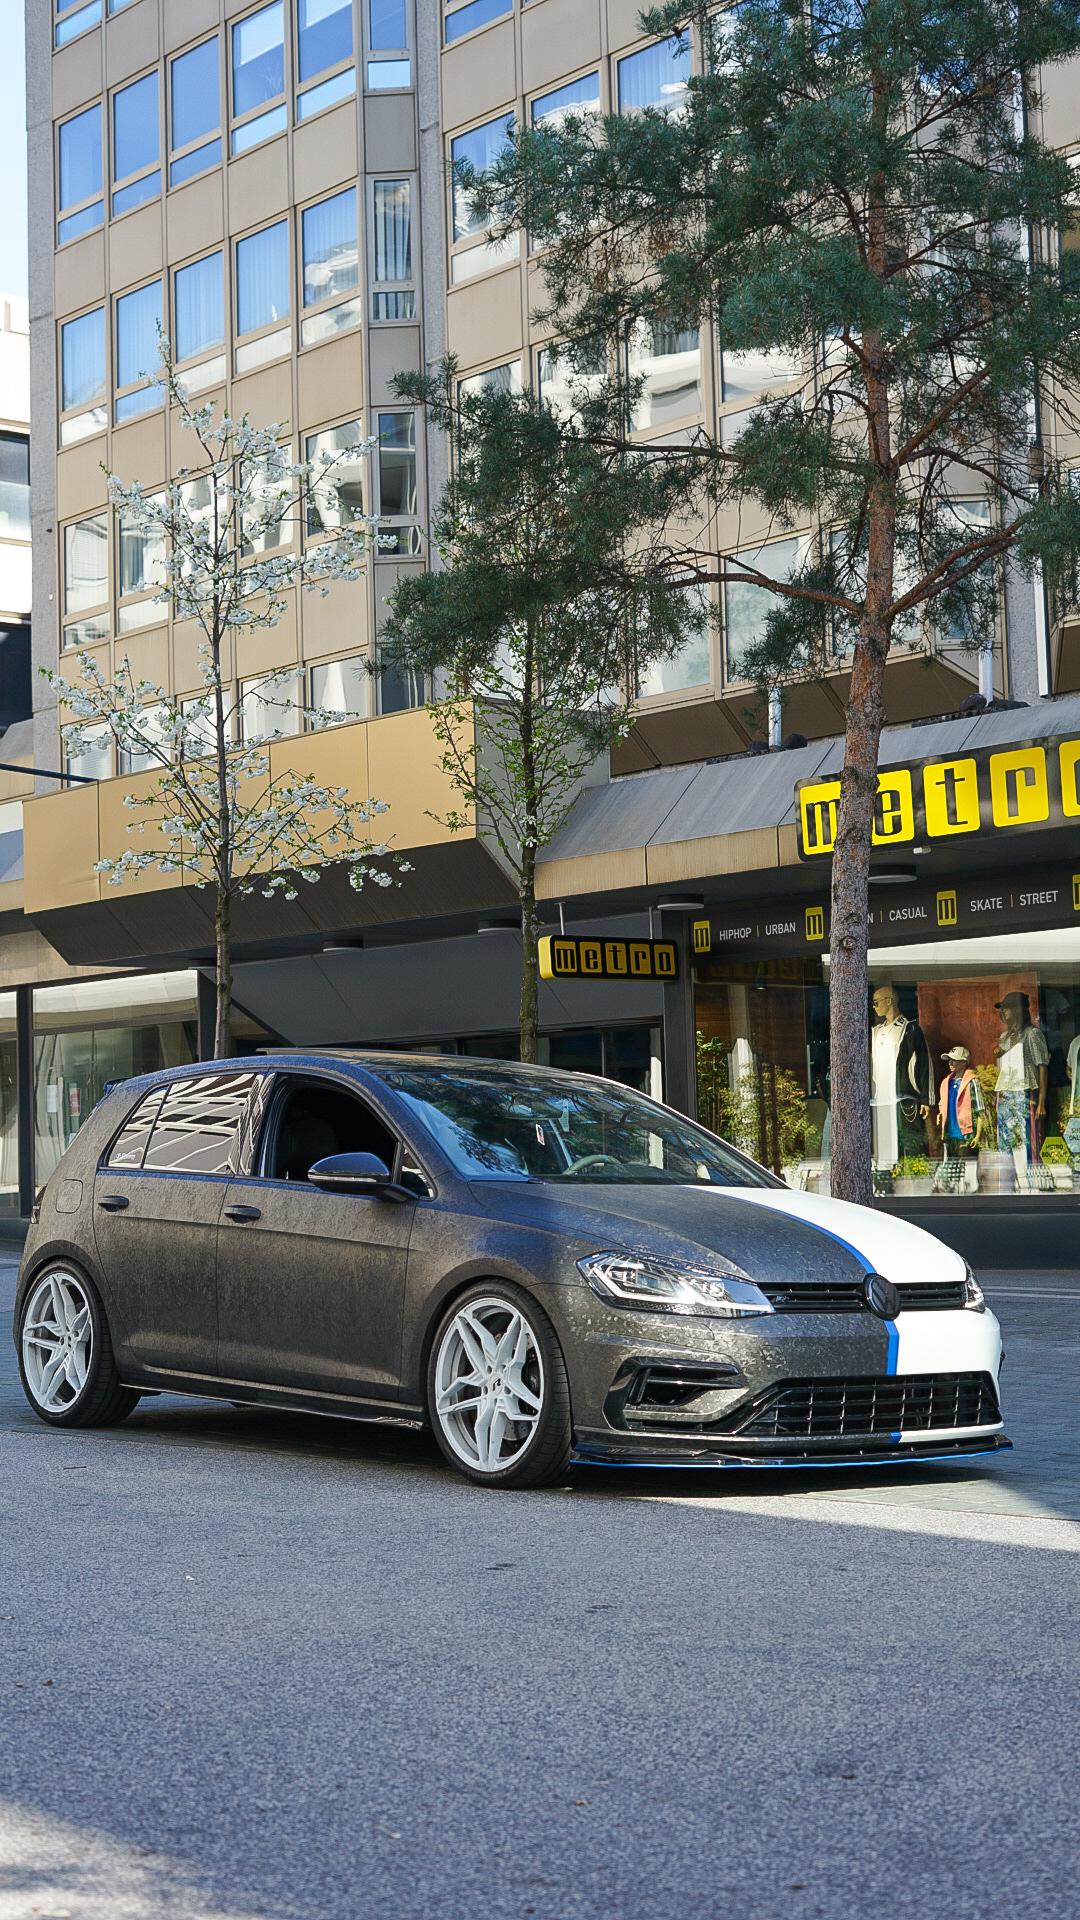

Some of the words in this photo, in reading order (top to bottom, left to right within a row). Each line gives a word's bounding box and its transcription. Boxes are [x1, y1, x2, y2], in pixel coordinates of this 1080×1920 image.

[805, 757, 1080, 848] metr
[719, 927, 752, 941] HIPHOP
[765, 922, 796, 936] URBAN
[889, 906, 928, 921] CASUAL
[970, 897, 1003, 912] SKATE
[1019, 890, 1059, 906] STREET
[556, 945, 671, 972] metro
